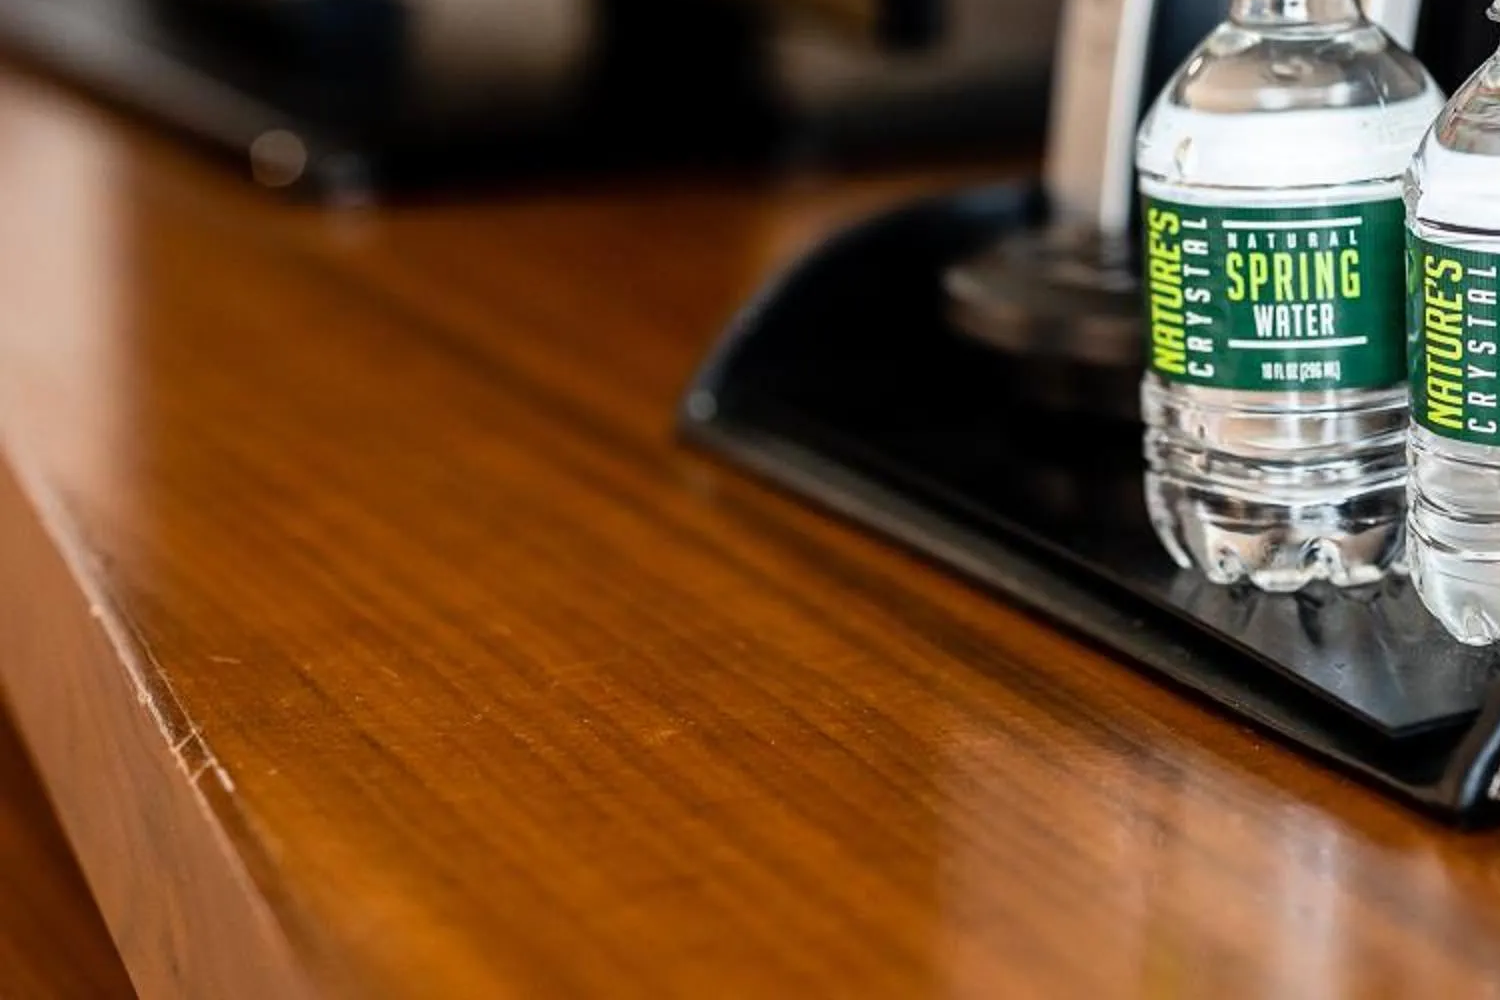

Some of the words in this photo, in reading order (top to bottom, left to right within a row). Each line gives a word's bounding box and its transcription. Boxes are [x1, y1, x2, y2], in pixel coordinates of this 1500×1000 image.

[1148, 208, 1186, 374] NATURE'S
[1182, 217, 1215, 378] CRYSTAL
[1226, 249, 1361, 301] SPRING
[1227, 229, 1358, 249] NATURAL
[1253, 303, 1336, 337] WATER
[1424, 255, 1463, 430] NATURE'S
[1467, 265, 1498, 434] CRYSTAL
